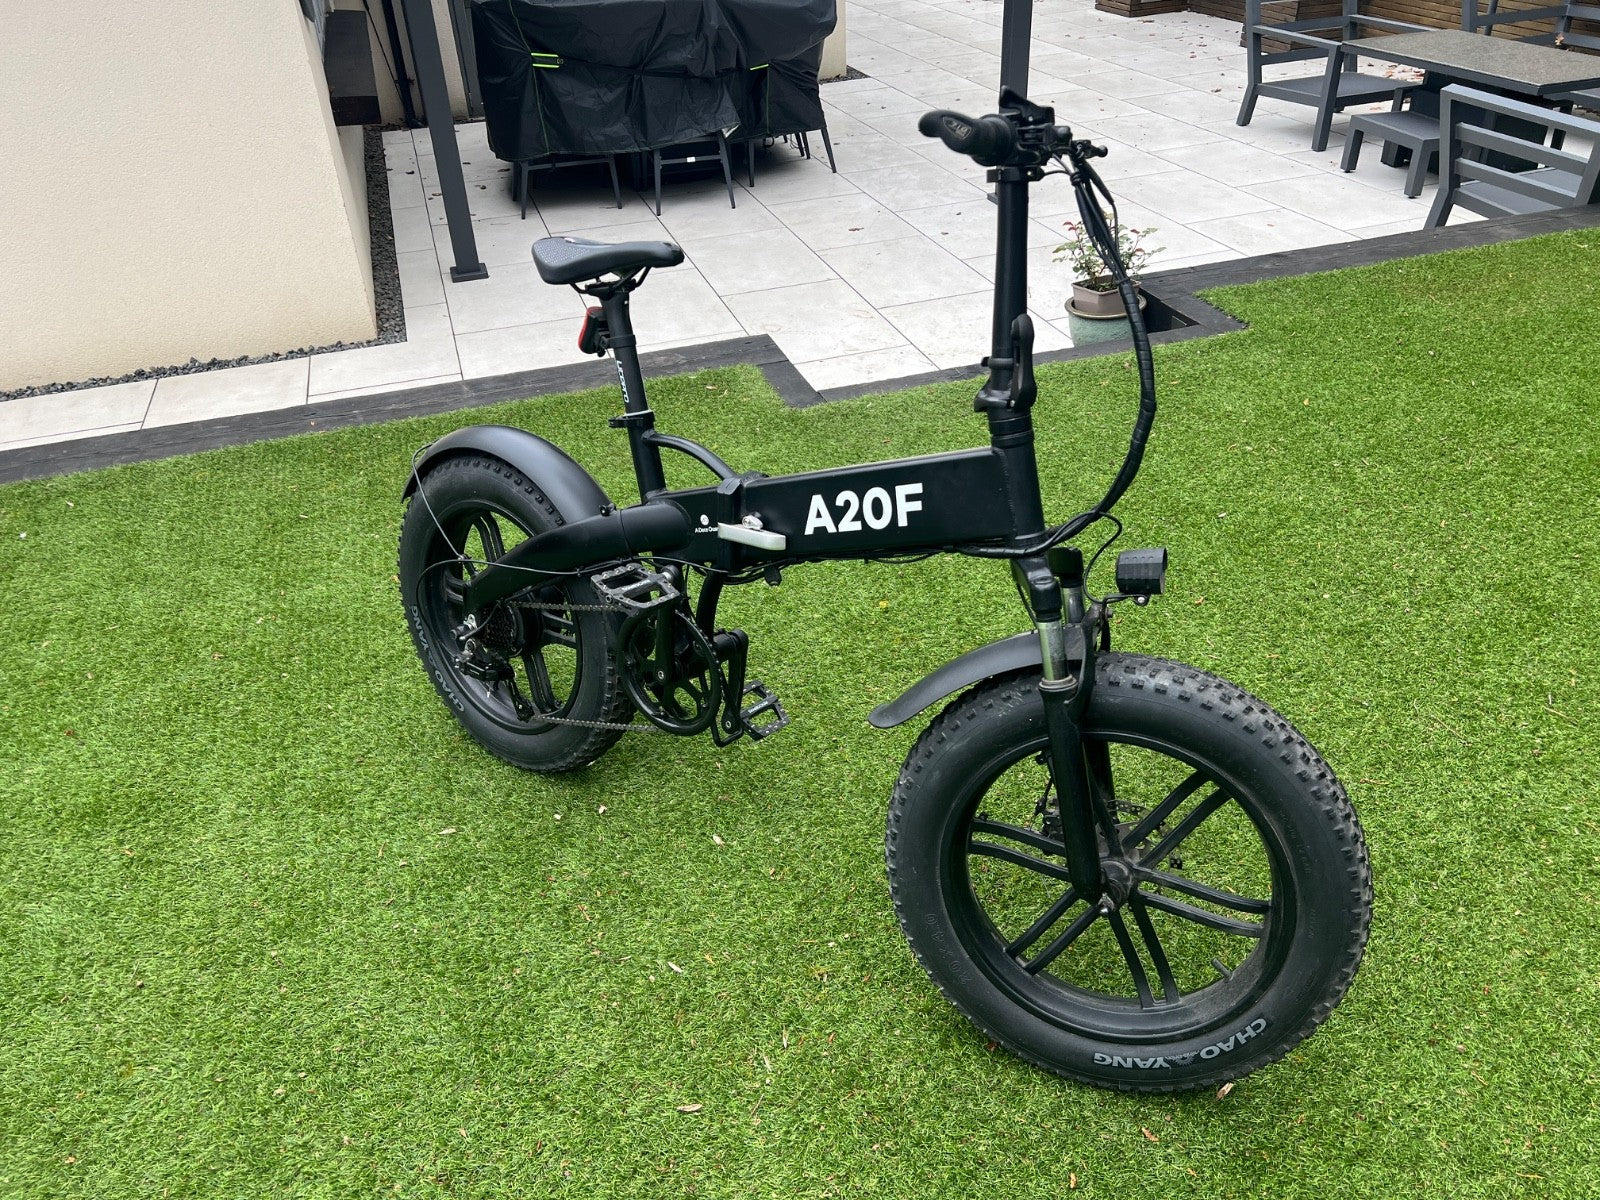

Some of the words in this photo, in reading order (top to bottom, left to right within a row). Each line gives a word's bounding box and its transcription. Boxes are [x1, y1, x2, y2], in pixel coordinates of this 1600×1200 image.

[804, 482, 924, 536] A20F
[411, 605, 429, 651] YANG
[434, 670, 465, 712] CHAO
[1199, 1018, 1267, 1059] CHAO
[1093, 1052, 1171, 1069] YANG
